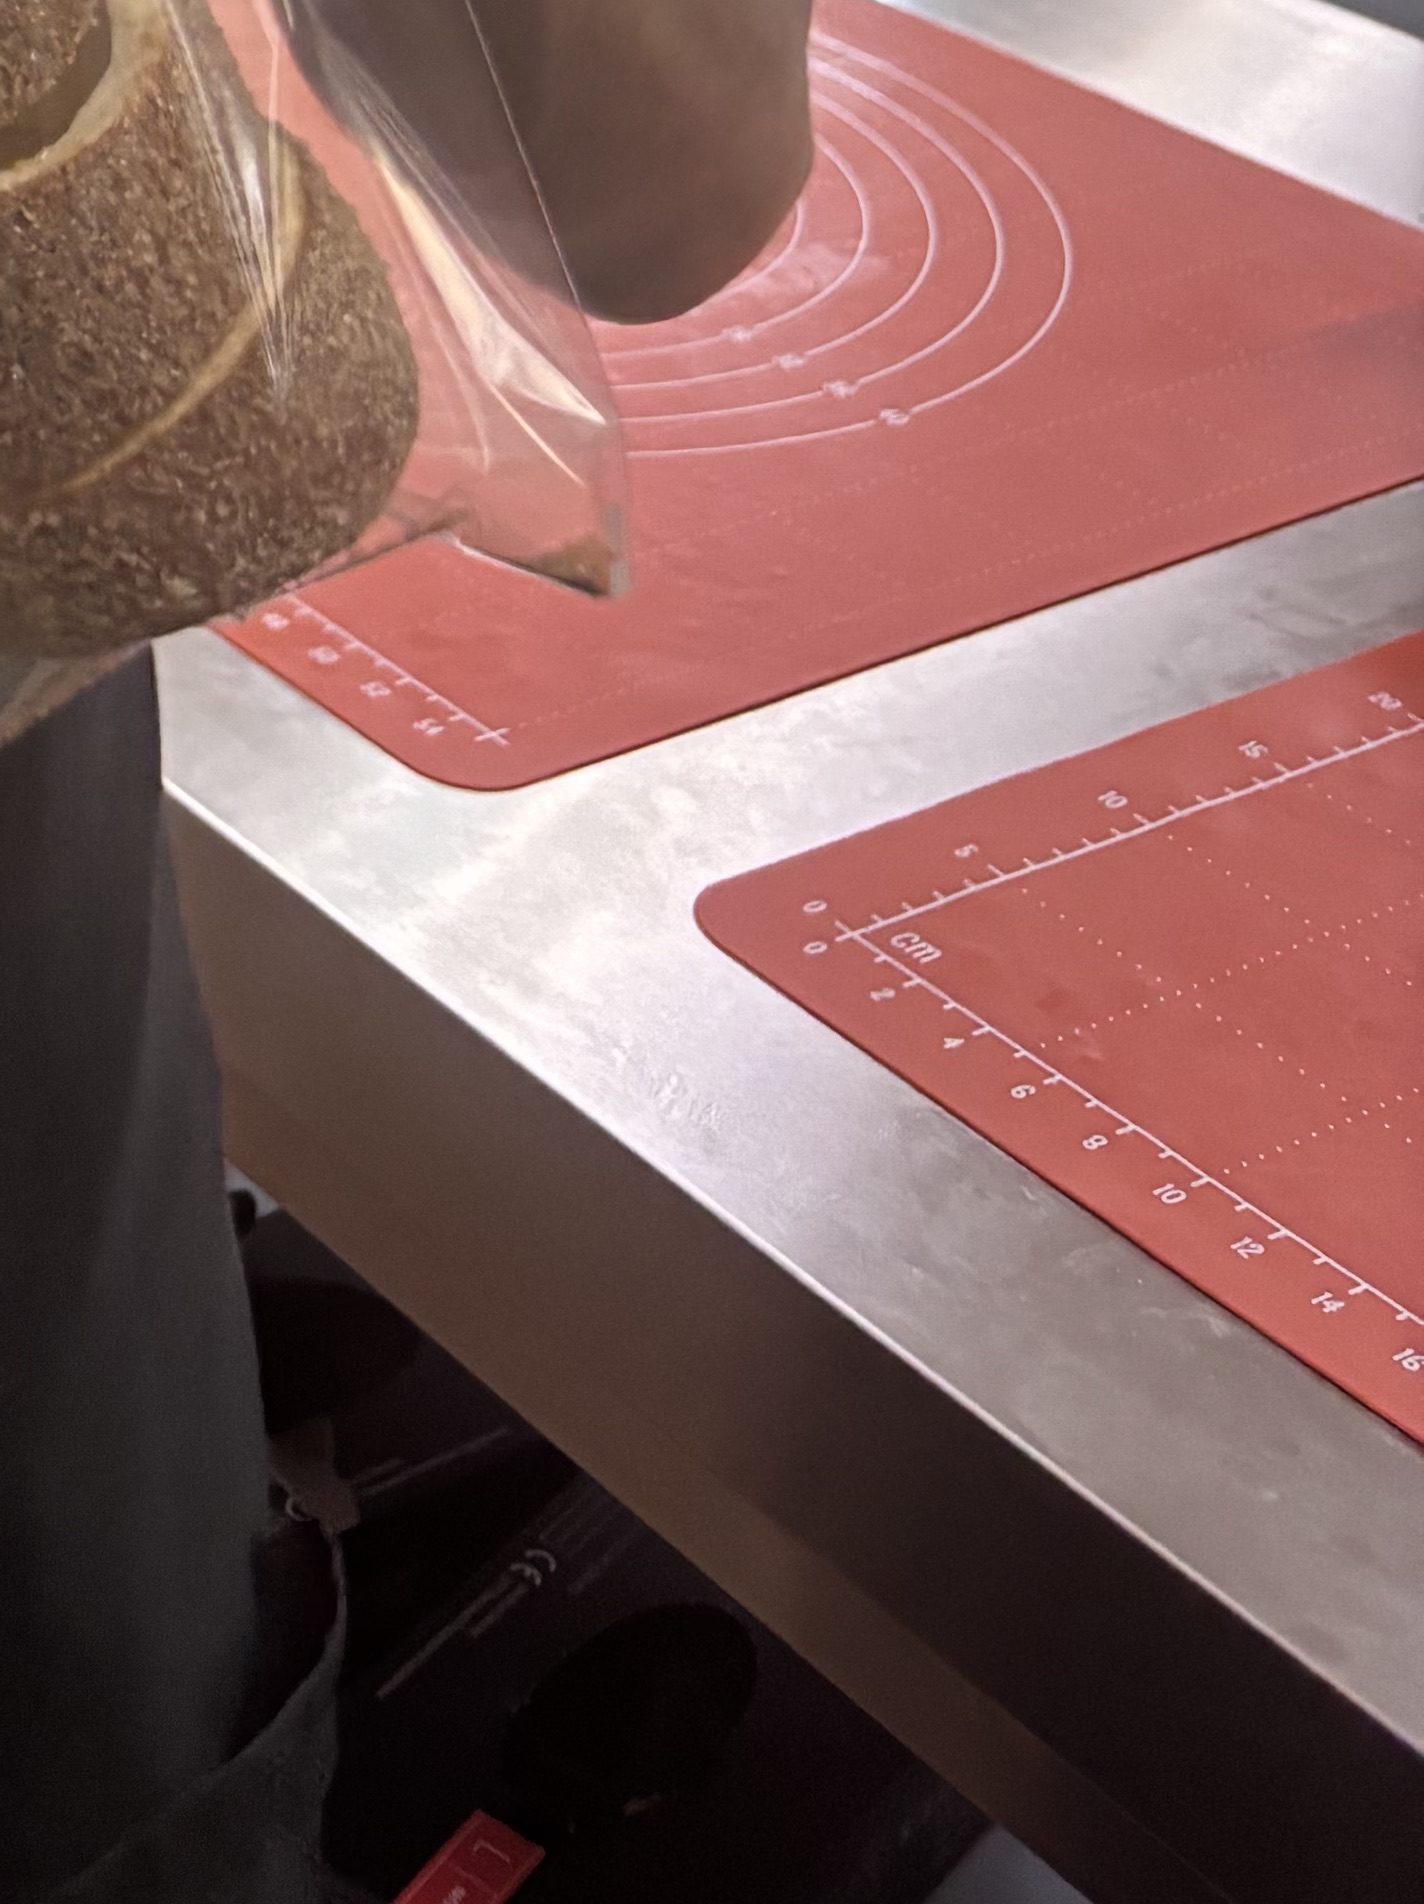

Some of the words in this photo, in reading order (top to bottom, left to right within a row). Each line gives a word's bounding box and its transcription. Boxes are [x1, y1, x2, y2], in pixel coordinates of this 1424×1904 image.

[802, 900, 828, 913] 0
[954, 844, 979, 858] 5
[1096, 790, 1128, 809] 10
[1238, 740, 1269, 759] 15
[1368, 692, 1402, 711] 20
[890, 932, 942, 964] cm
[803, 941, 828, 954] 0
[943, 1037, 965, 1049] 4
[1010, 1084, 1036, 1099] 6
[1082, 1134, 1108, 1150] 8
[1152, 1184, 1187, 1204] 10
[1230, 1237, 1265, 1259] 12
[1311, 1292, 1345, 1312] 14
[1392, 1348, 1424, 1371] 16
